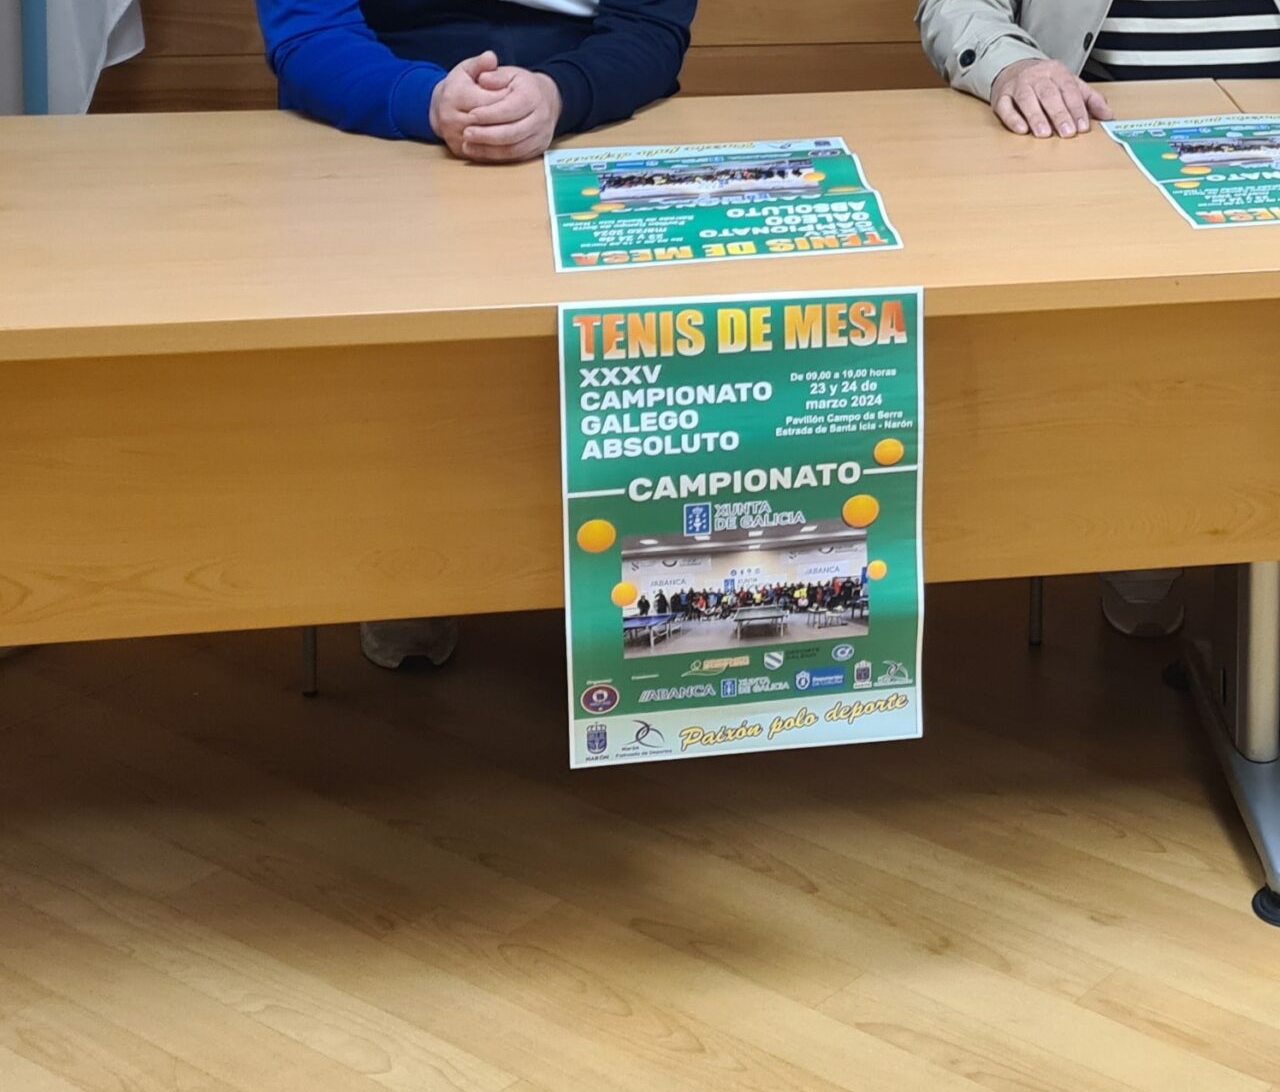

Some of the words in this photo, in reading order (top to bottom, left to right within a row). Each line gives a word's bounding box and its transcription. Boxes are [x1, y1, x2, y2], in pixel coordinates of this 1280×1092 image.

[726, 201, 866, 217] ABSOLUTO
[702, 240, 757, 257] DE
[770, 231, 889, 253] TENIS
[571, 245, 695, 265] MESA
[573, 309, 705, 361] TENIS
[717, 306, 773, 354] DE
[784, 300, 907, 350] MESA
[578, 364, 663, 388] XXXV
[790, 372, 804, 381] De
[869, 368, 897, 377] horas
[580, 381, 773, 412] CAMPIONATO
[810, 383, 826, 395] 23
[829, 383, 838, 396] y
[841, 381, 857, 393] 24
[861, 380, 877, 392] de
[805, 398, 848, 410] marzo
[851, 394, 882, 407] 2024
[581, 409, 699, 436] GALEGO
[827, 413, 860, 424] Campo
[877, 411, 903, 420] Serra
[776, 426, 813, 437] Estrada
[815, 424, 827, 434] de
[829, 423, 857, 433] Santa
[581, 430, 740, 461] ABSOLUTO
[627, 460, 862, 502] CAMPIONATO
[714, 501, 772, 519] XUNTA
[714, 517, 738, 532] DE
[739, 510, 806, 529] GALICIA
[640, 683, 716, 703] ABANCA
[680, 717, 763, 752] Paixón
[768, 709, 818, 736] polo
[822, 693, 909, 727] deporte
